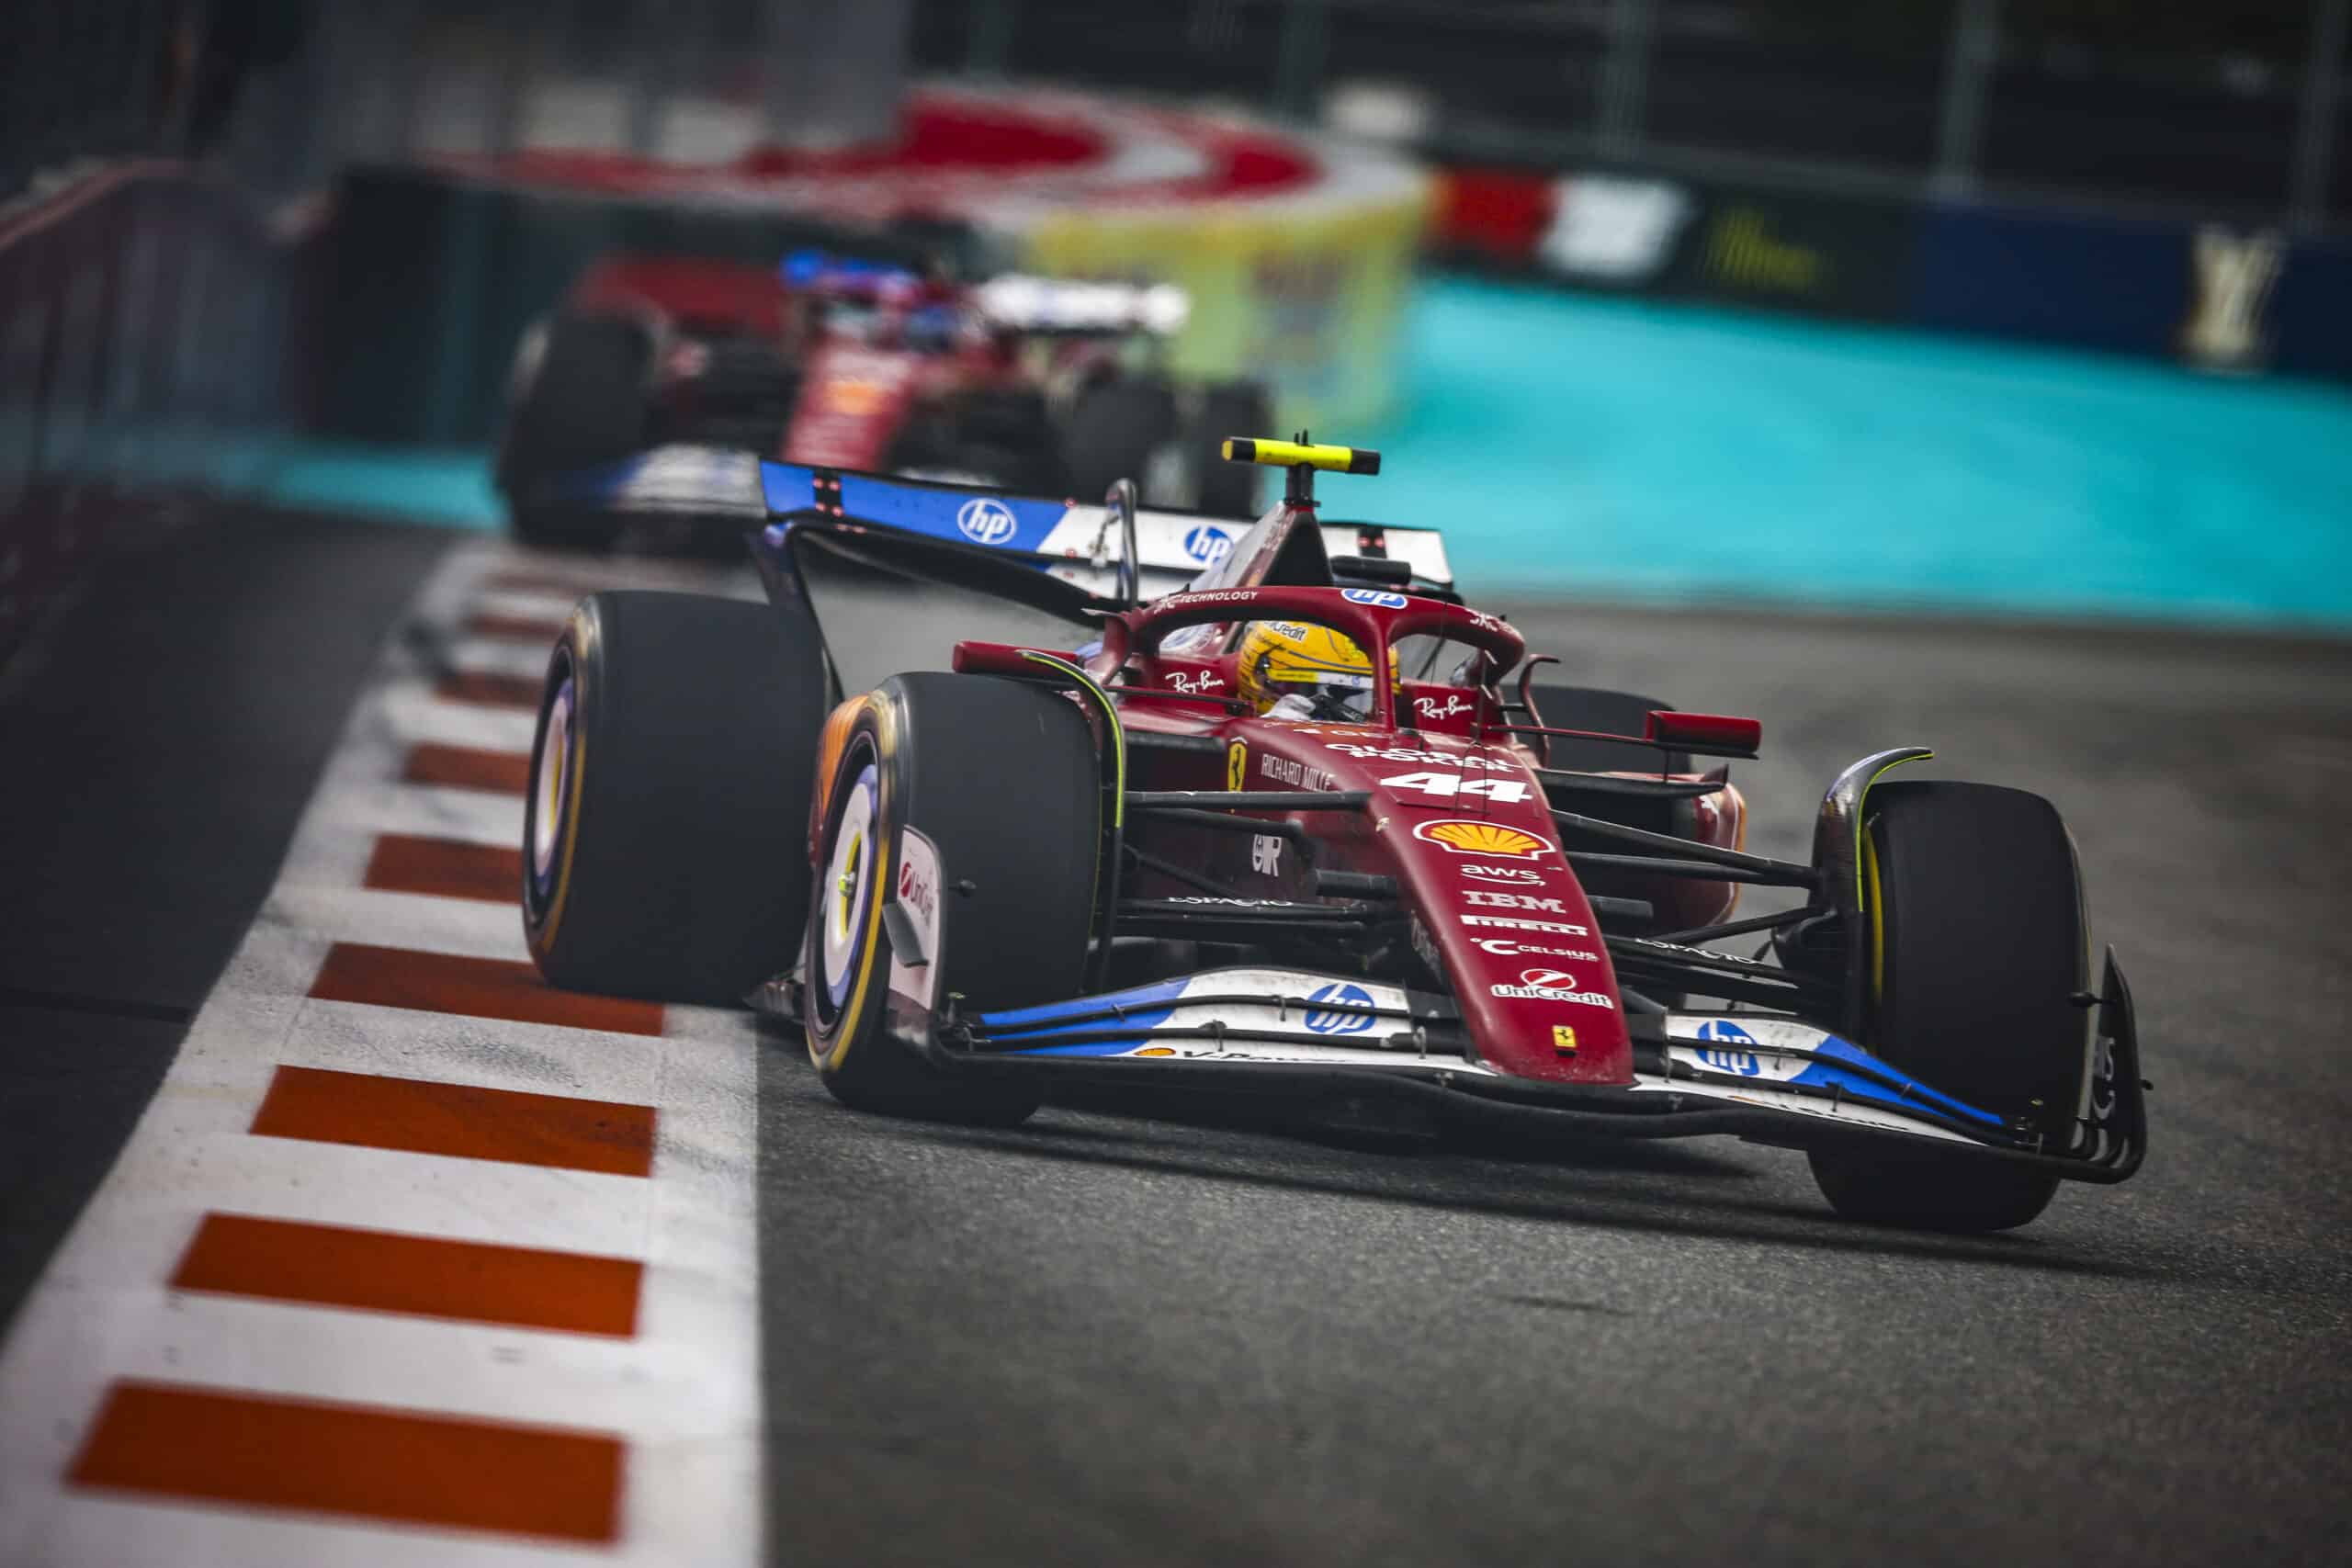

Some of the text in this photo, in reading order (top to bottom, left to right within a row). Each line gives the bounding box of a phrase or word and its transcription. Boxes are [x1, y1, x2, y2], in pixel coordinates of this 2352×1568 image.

[962, 498, 1012, 545] hp
[1182, 591, 1259, 604] TECHNOLOGY
[1165, 670, 1225, 694] Ray-Ban
[1413, 695, 1473, 720] Ray-Ban
[1261, 753, 1302, 786] RICHARD
[1380, 772, 1532, 803] 44
[1461, 864, 1542, 881] aws
[1462, 890, 1566, 914] IBM
[1517, 944, 1598, 960] CELSIUS
[1308, 984, 1373, 1034] hp
[1491, 985, 1614, 1009] UniCredit
